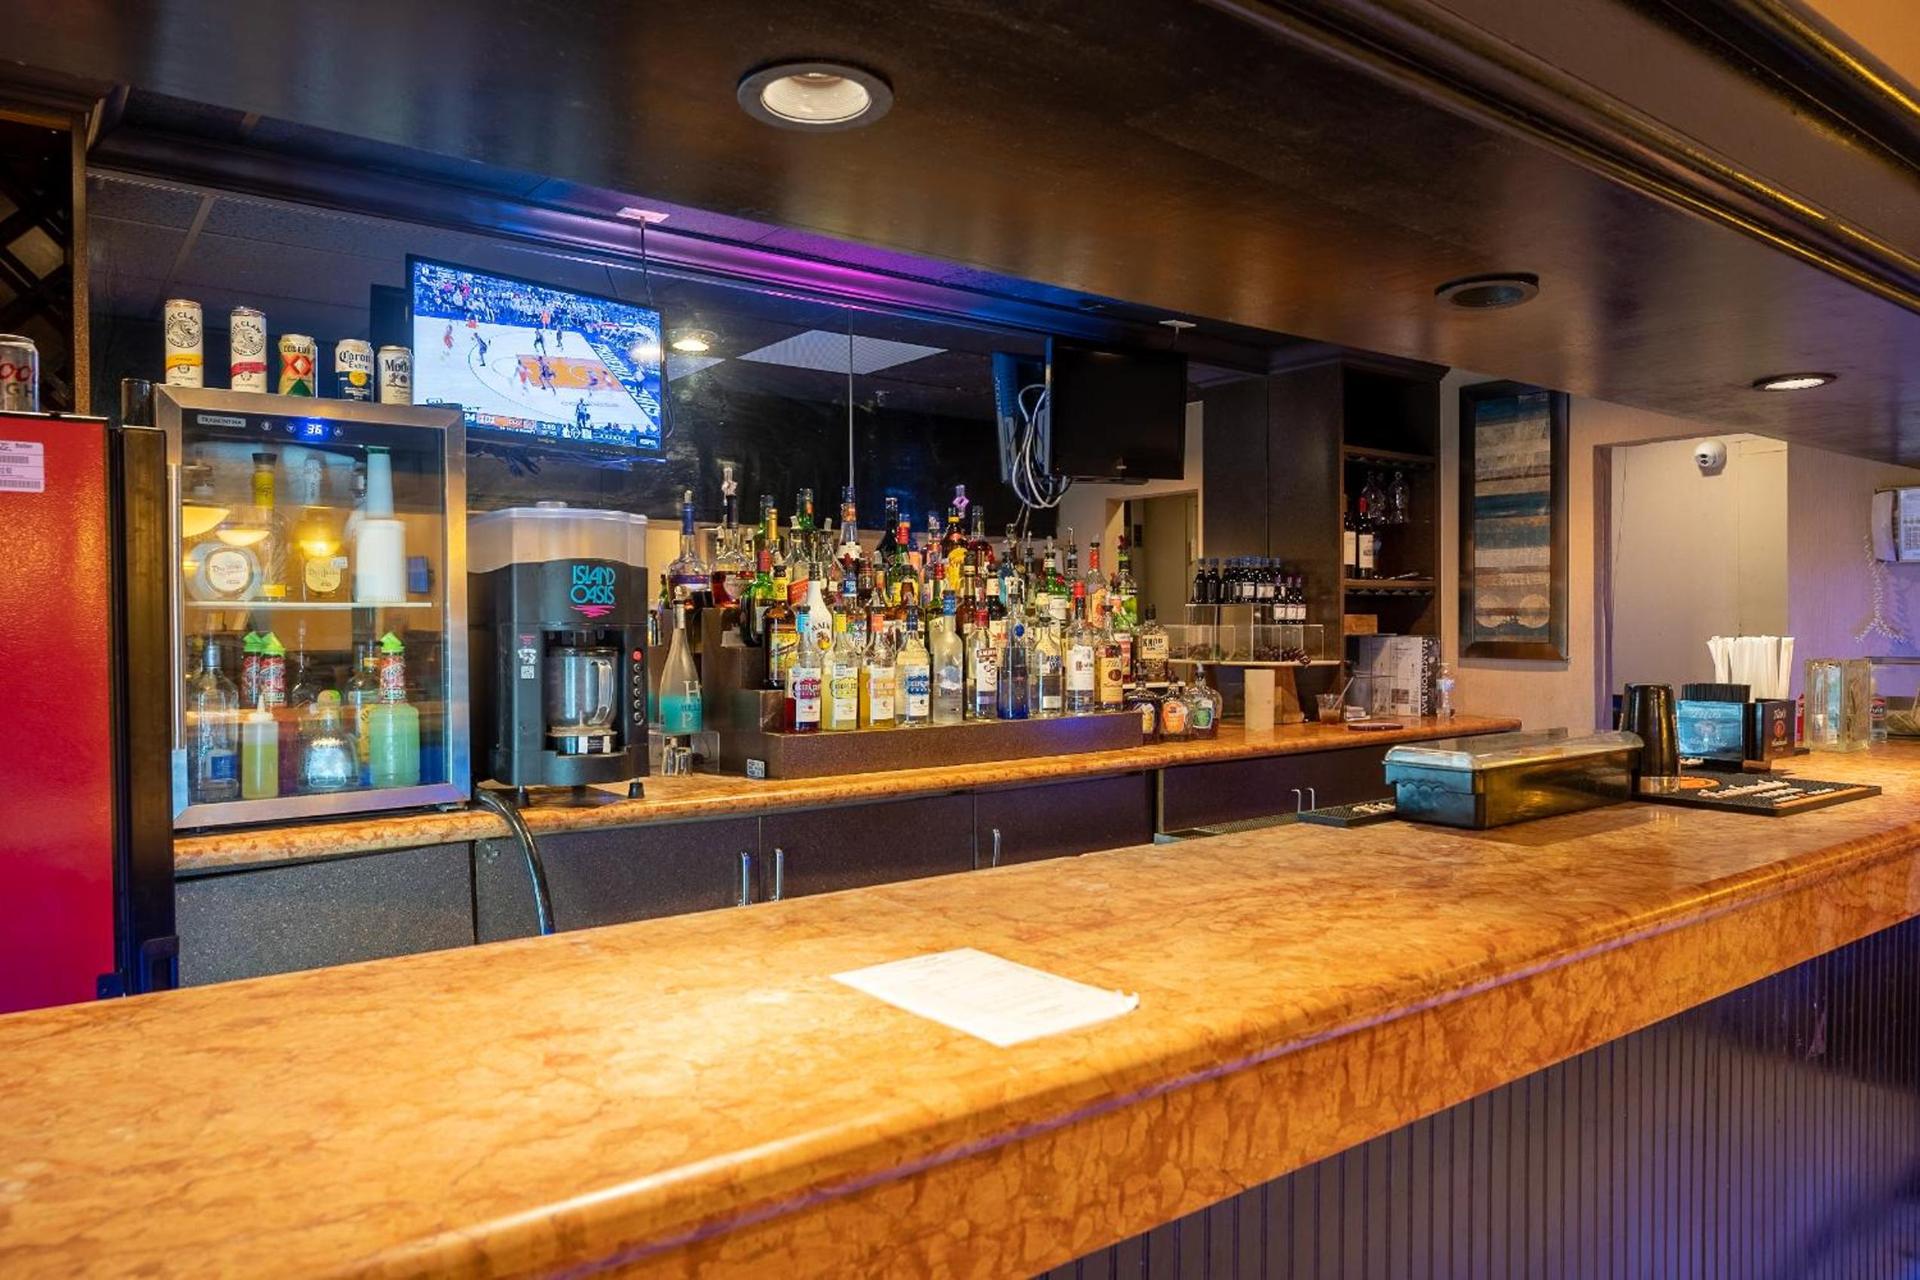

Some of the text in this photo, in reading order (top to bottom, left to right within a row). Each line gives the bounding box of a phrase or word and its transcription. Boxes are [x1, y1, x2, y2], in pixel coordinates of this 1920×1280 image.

[306, 424, 323, 435] 36
[572, 564, 616, 585] ISLAND
[570, 584, 616, 605] OASIS
[1421, 639, 1430, 715] HAMPTON BAY
